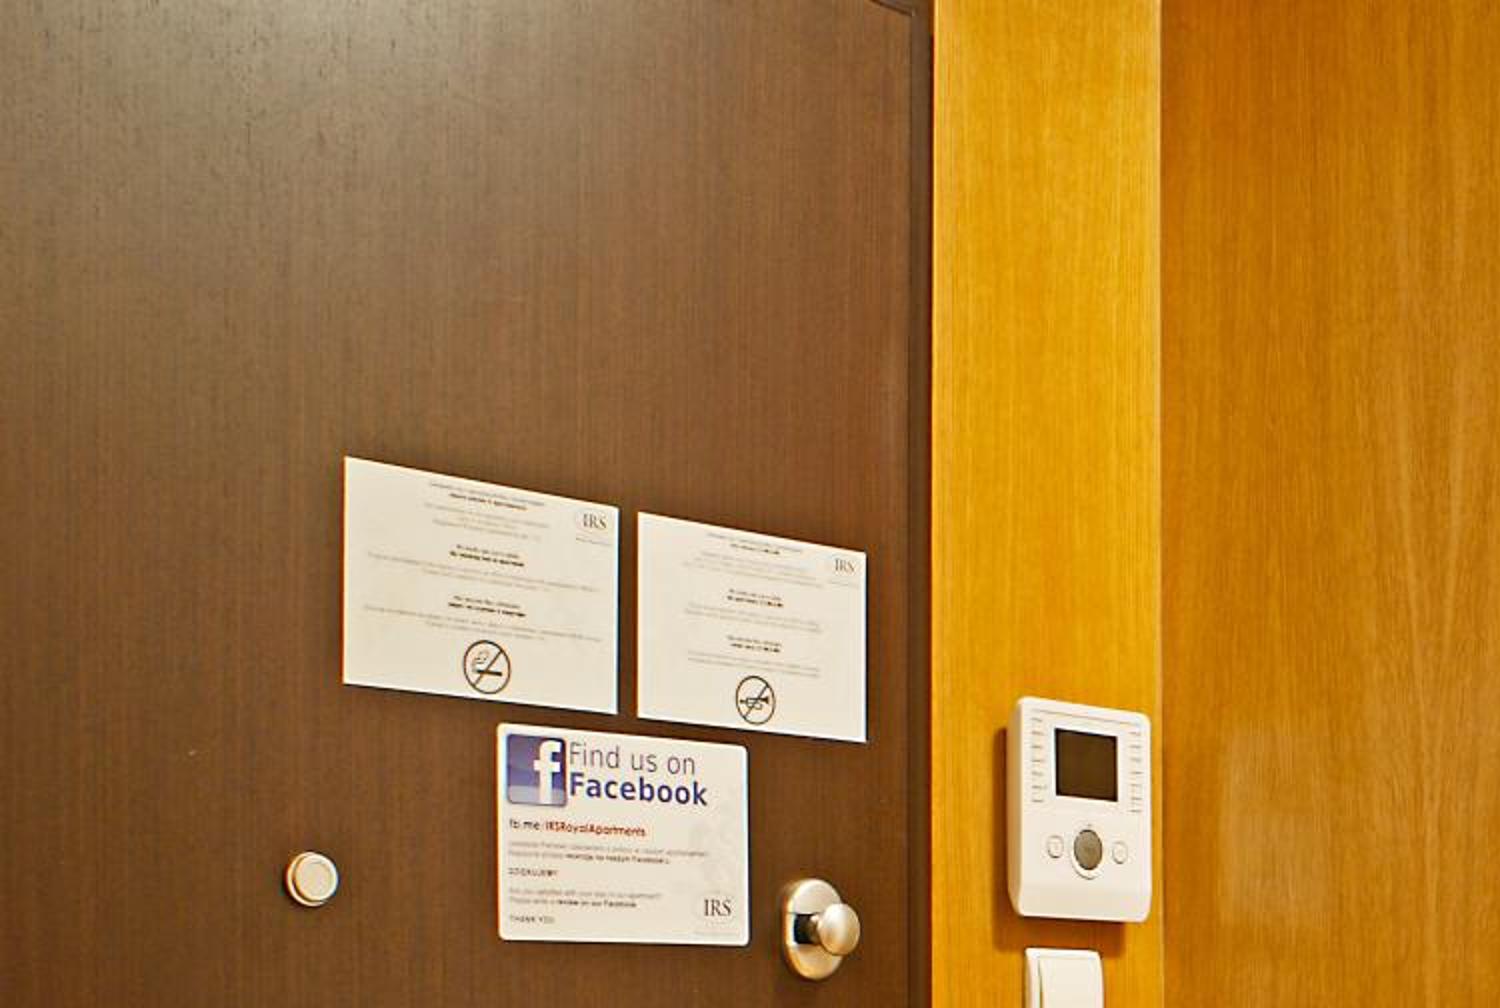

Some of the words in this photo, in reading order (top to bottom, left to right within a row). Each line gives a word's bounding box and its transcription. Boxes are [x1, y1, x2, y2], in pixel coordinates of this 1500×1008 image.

[583, 512, 607, 529] IRS
[835, 558, 856, 573] IRS
[569, 742, 620, 769] Find
[631, 753, 658, 773] us
[667, 755, 696, 775] on
[570, 771, 708, 806] Facebook
[703, 898, 732, 917] IRS
